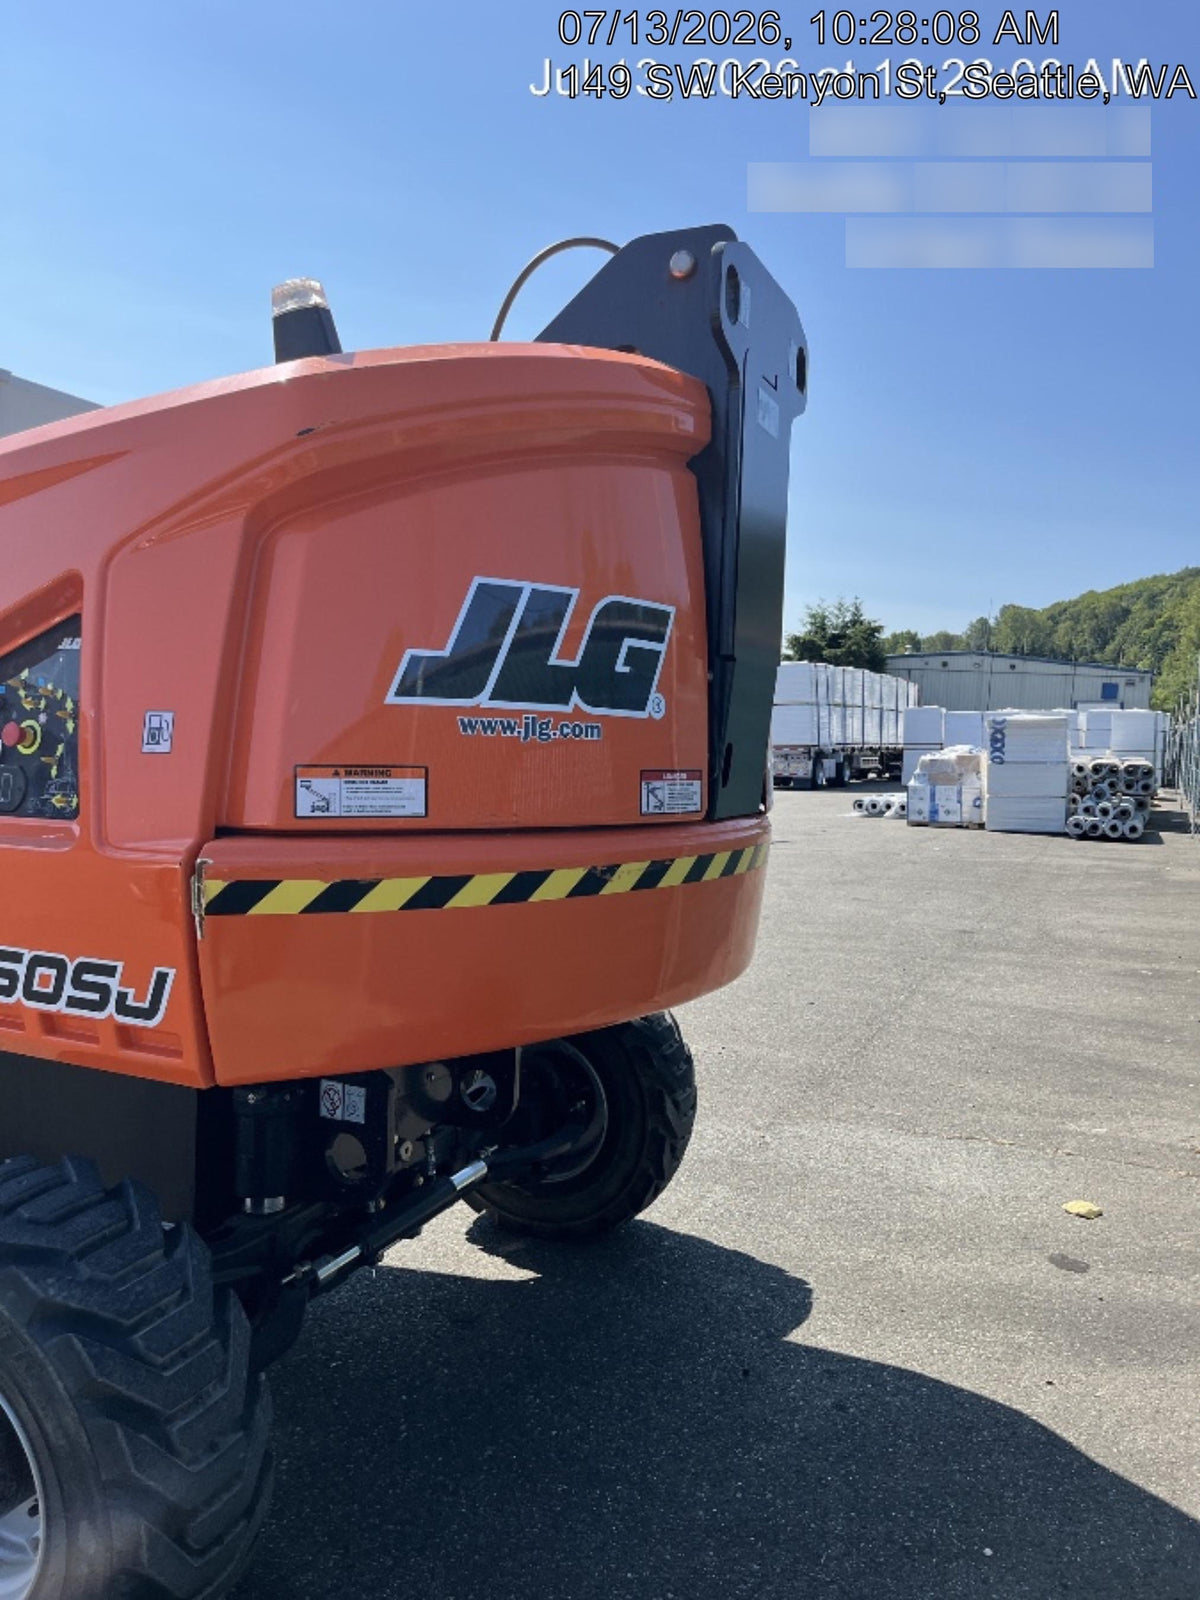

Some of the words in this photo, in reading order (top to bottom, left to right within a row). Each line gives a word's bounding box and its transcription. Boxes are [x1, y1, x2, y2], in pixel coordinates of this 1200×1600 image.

[384, 576, 675, 718] JLG
[457, 715, 602, 742] www.jlg.com
[344, 769, 392, 778] WARNING
